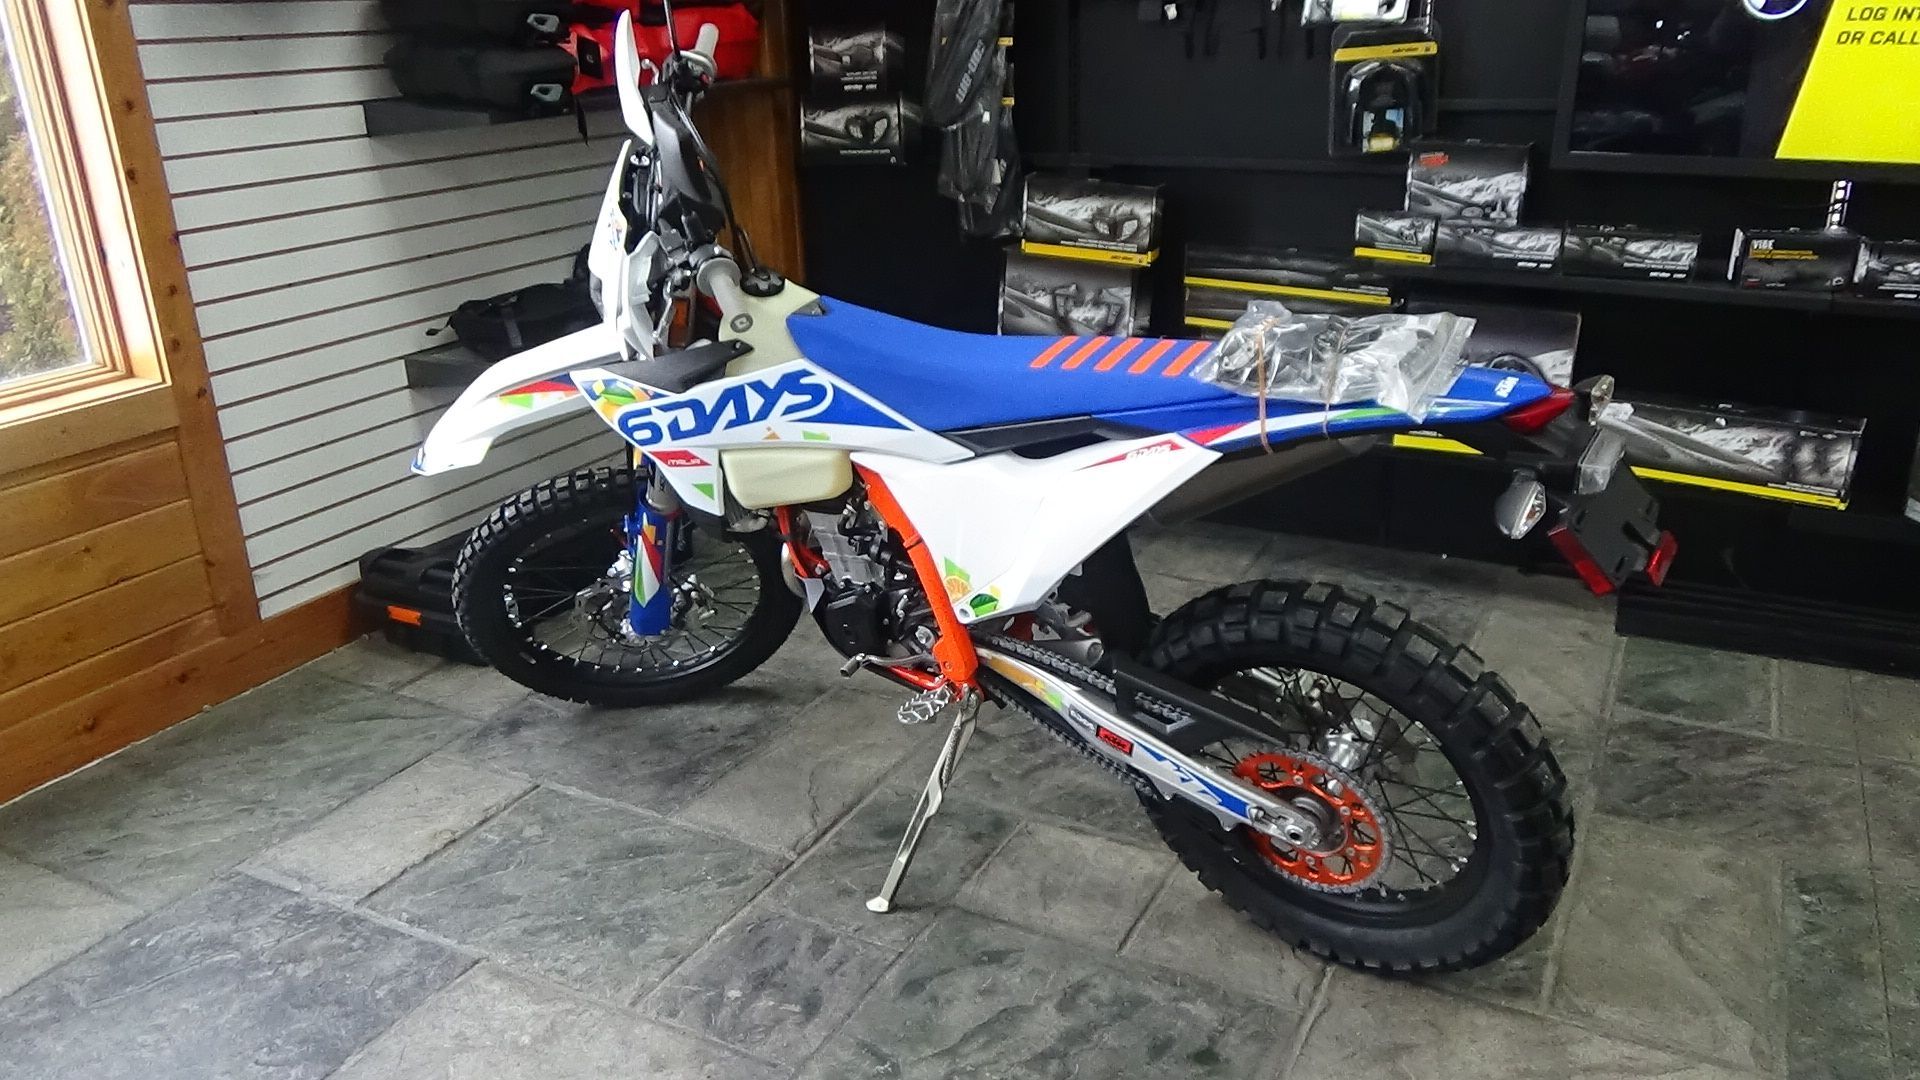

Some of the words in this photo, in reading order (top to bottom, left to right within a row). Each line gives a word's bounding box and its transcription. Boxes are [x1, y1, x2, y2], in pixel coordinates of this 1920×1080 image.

[1846, 6, 1888, 21] LOG
[1837, 31, 1865, 45] OR
[1869, 31, 1920, 45] CALL
[618, 368, 828, 447] 6DAYS
